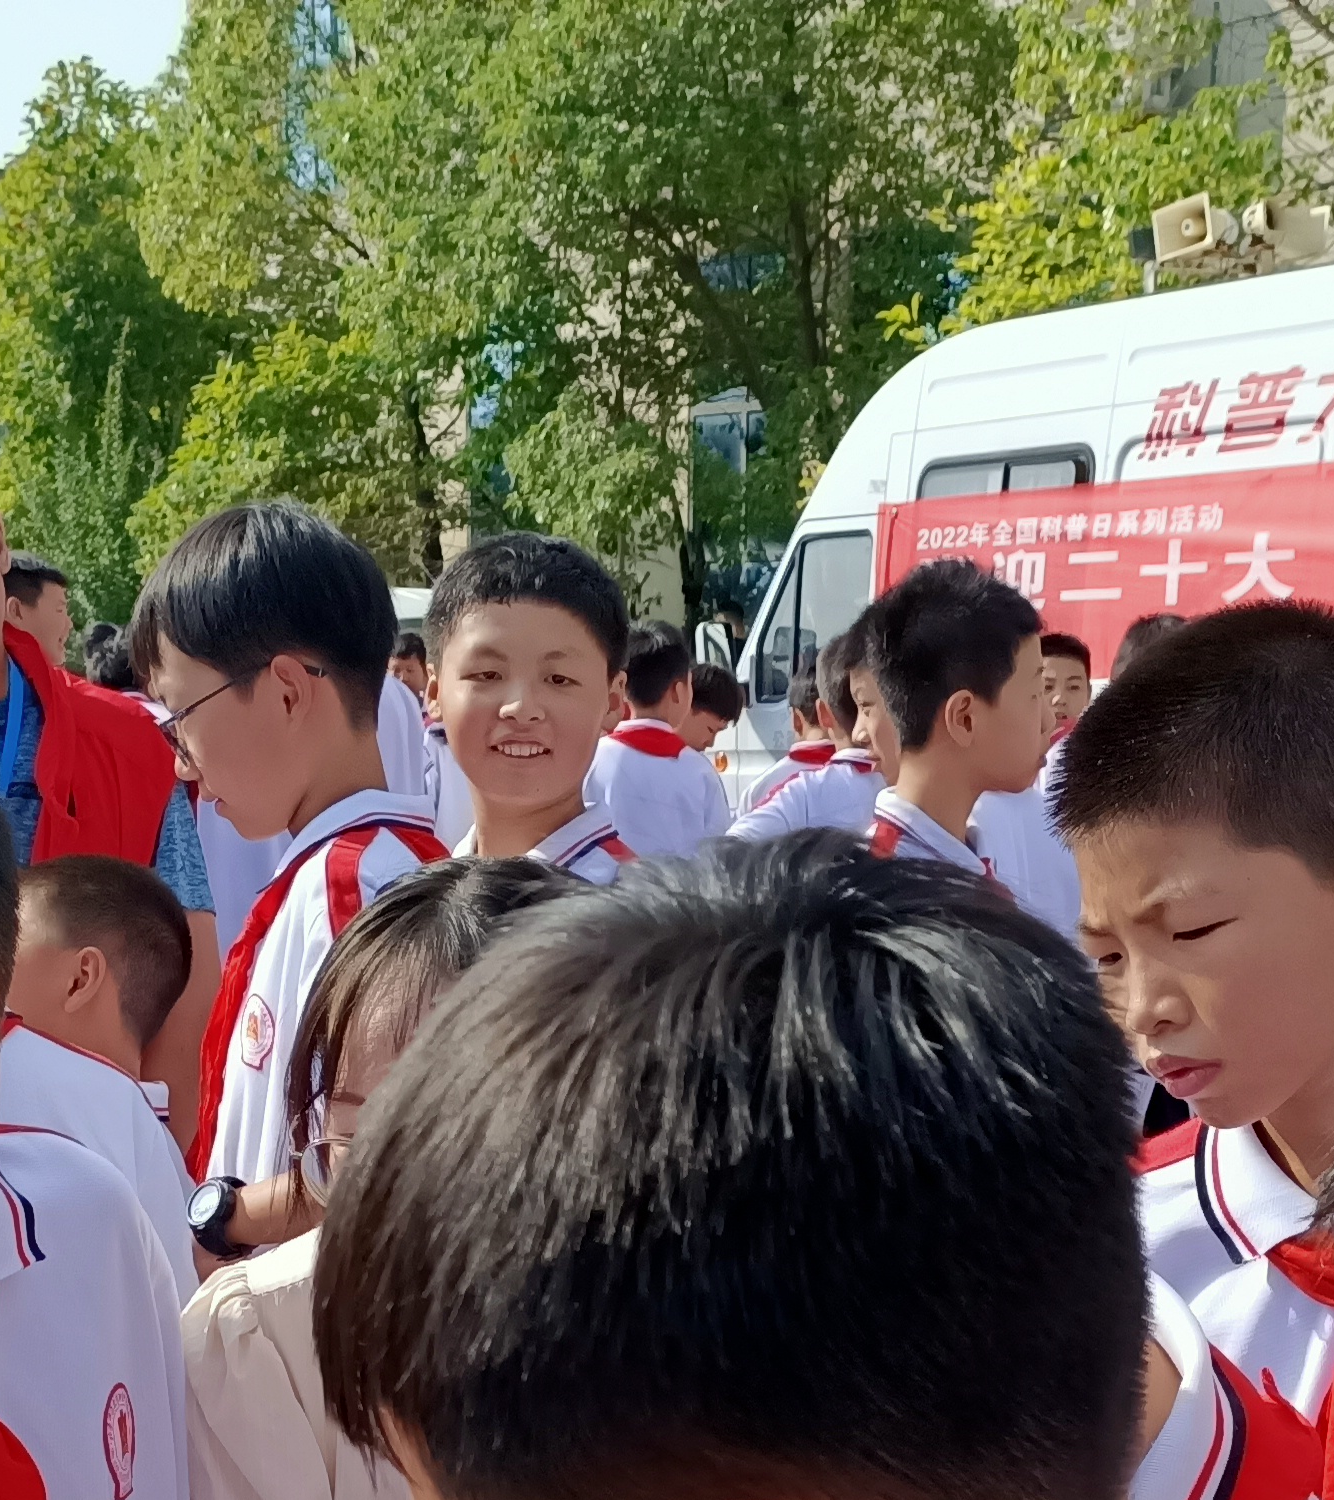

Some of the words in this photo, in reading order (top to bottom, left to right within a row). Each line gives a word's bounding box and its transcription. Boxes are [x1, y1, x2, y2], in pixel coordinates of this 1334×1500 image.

[916, 501, 1224, 550] 2022年全国科普日系列活动
[918, 531, 1296, 611] 迎二十大
